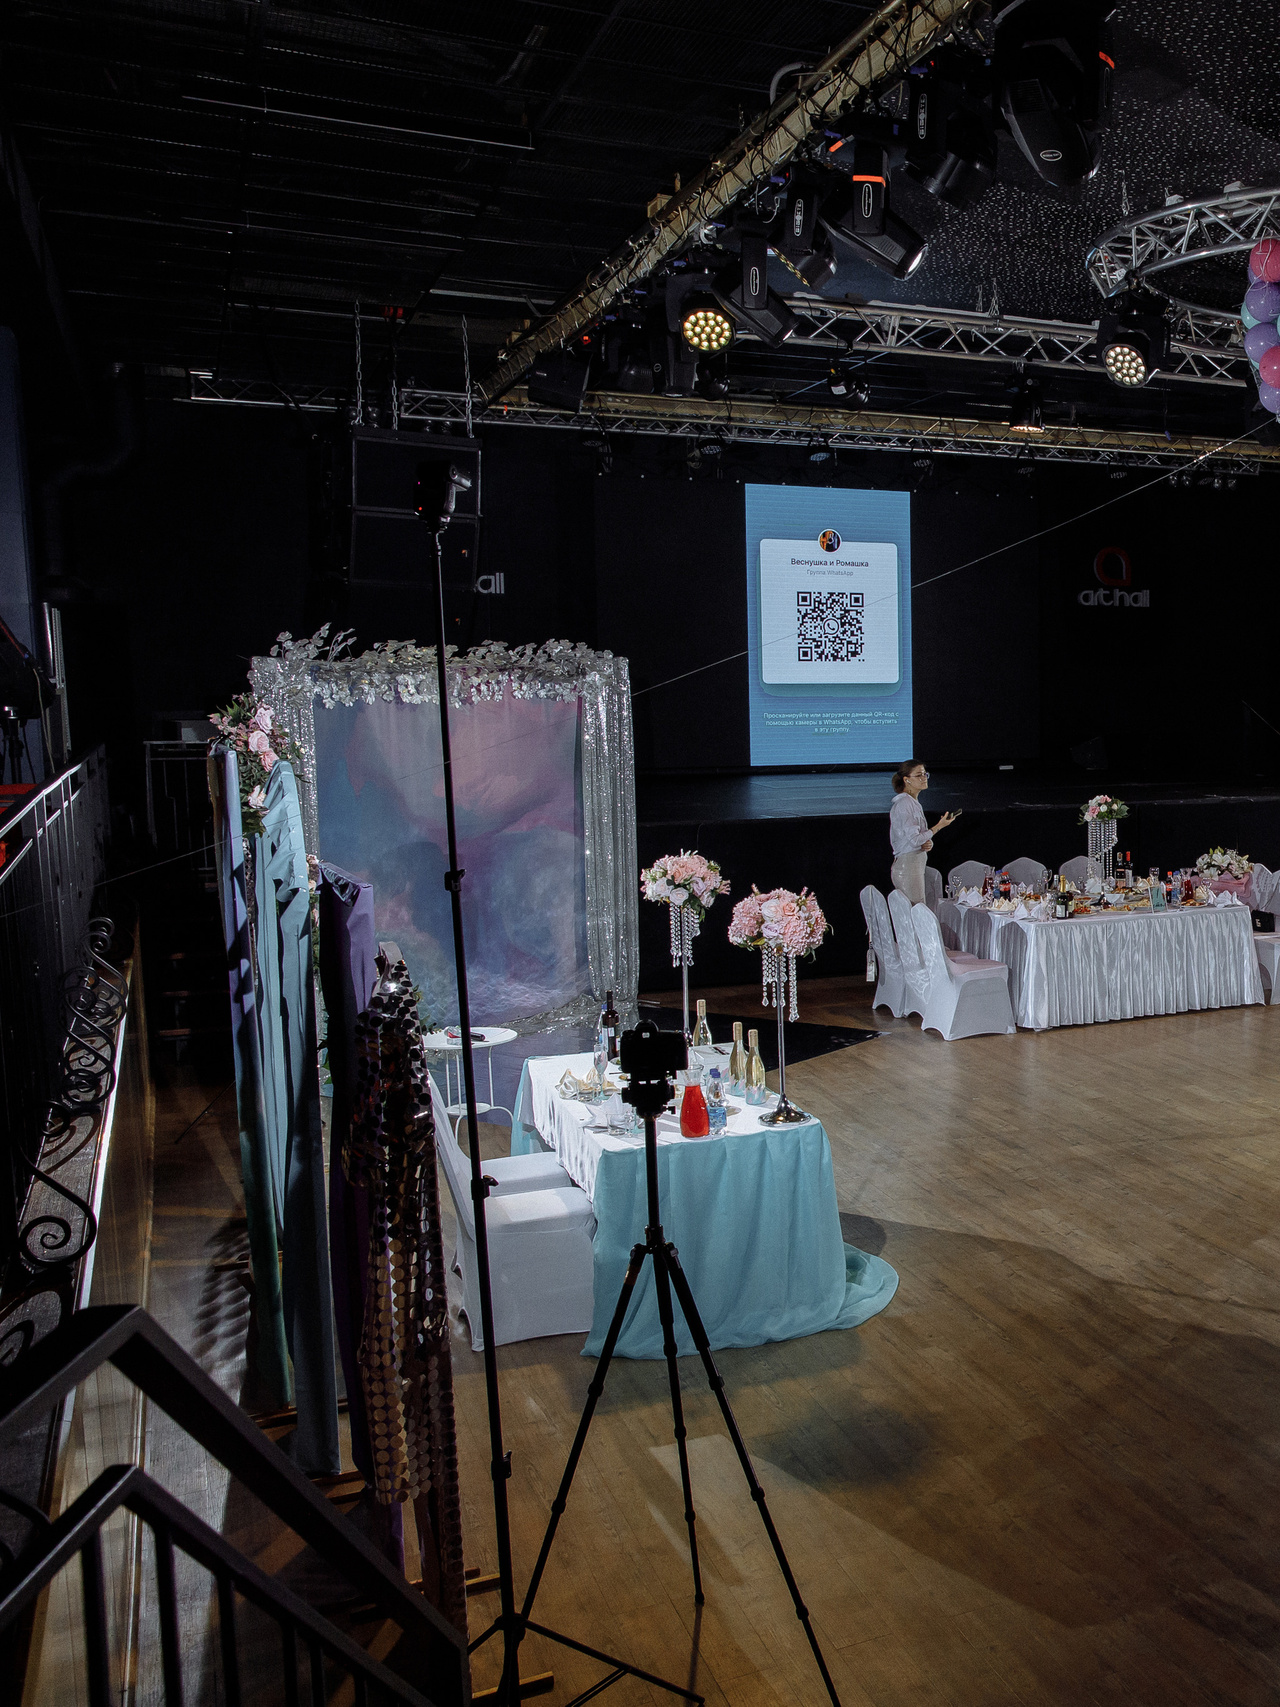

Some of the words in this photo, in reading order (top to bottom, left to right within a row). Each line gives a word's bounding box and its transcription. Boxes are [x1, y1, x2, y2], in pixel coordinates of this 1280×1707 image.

[791, 558, 828, 567] Веснушка
[835, 559, 869, 567] Ромашка
[476, 572, 505, 594] all
[763, 711, 810, 719] Просканируйте
